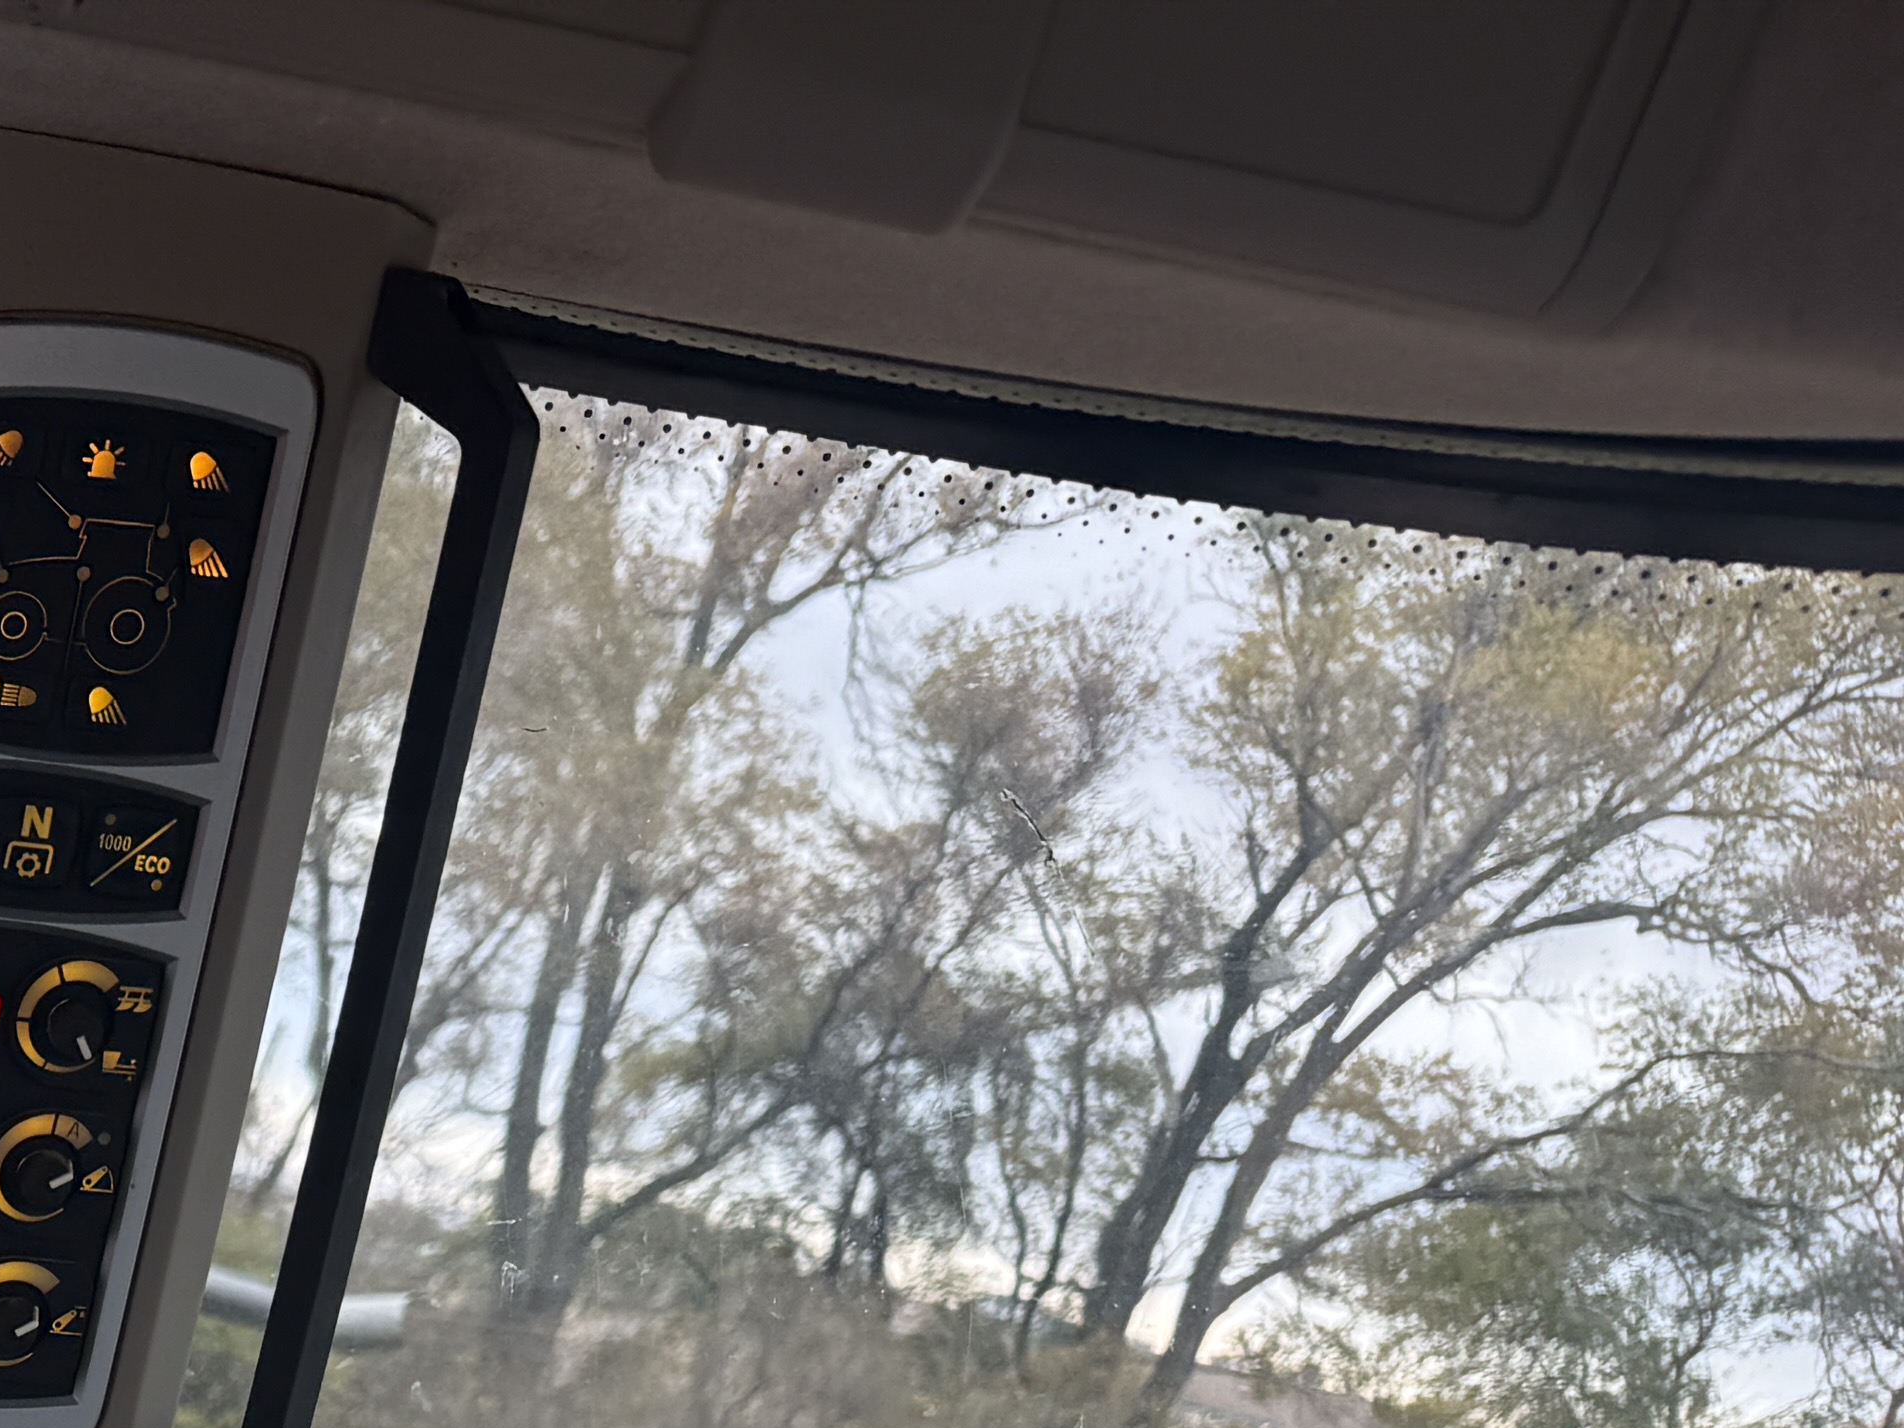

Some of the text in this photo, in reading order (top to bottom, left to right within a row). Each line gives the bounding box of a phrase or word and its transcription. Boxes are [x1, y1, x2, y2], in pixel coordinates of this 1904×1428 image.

[20, 804, 54, 839] N
[98, 832, 133, 852] 1000
[133, 854, 171, 874] ECO
